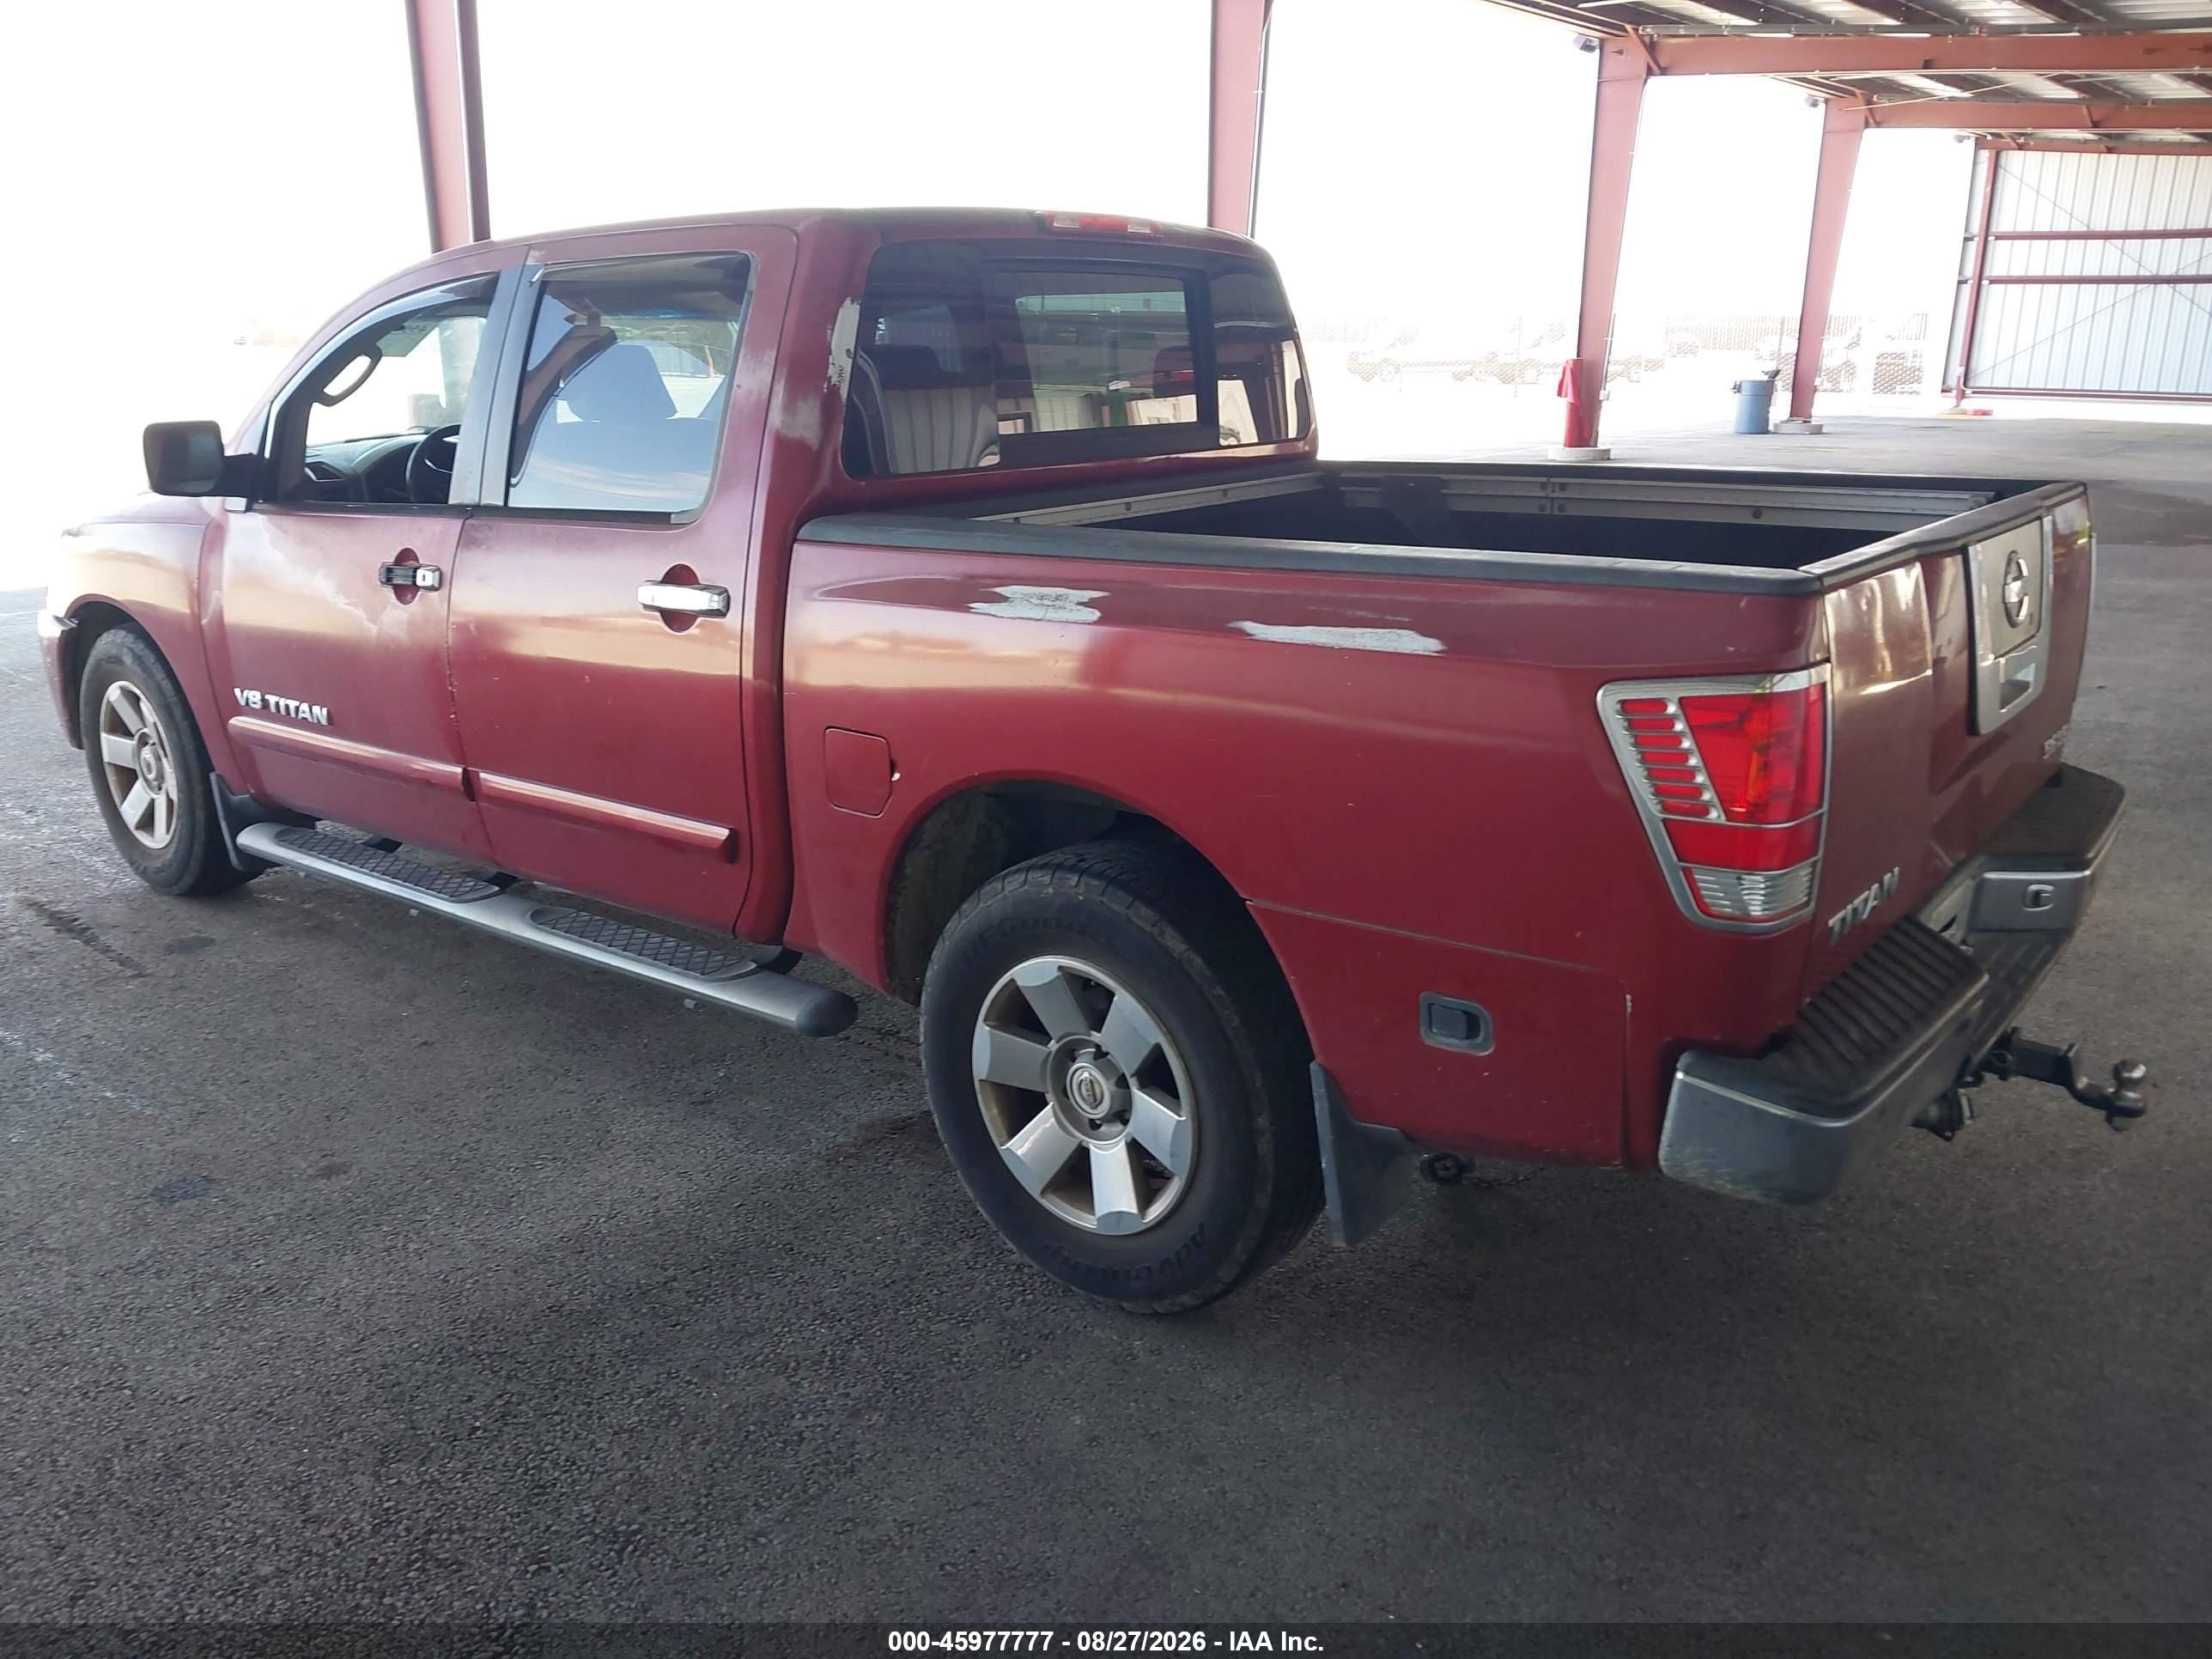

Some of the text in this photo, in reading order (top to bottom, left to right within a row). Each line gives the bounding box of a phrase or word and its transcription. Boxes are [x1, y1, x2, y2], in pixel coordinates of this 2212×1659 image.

[233, 687, 329, 726] V8 TITAN
[1827, 866, 1901, 946] TITAN
